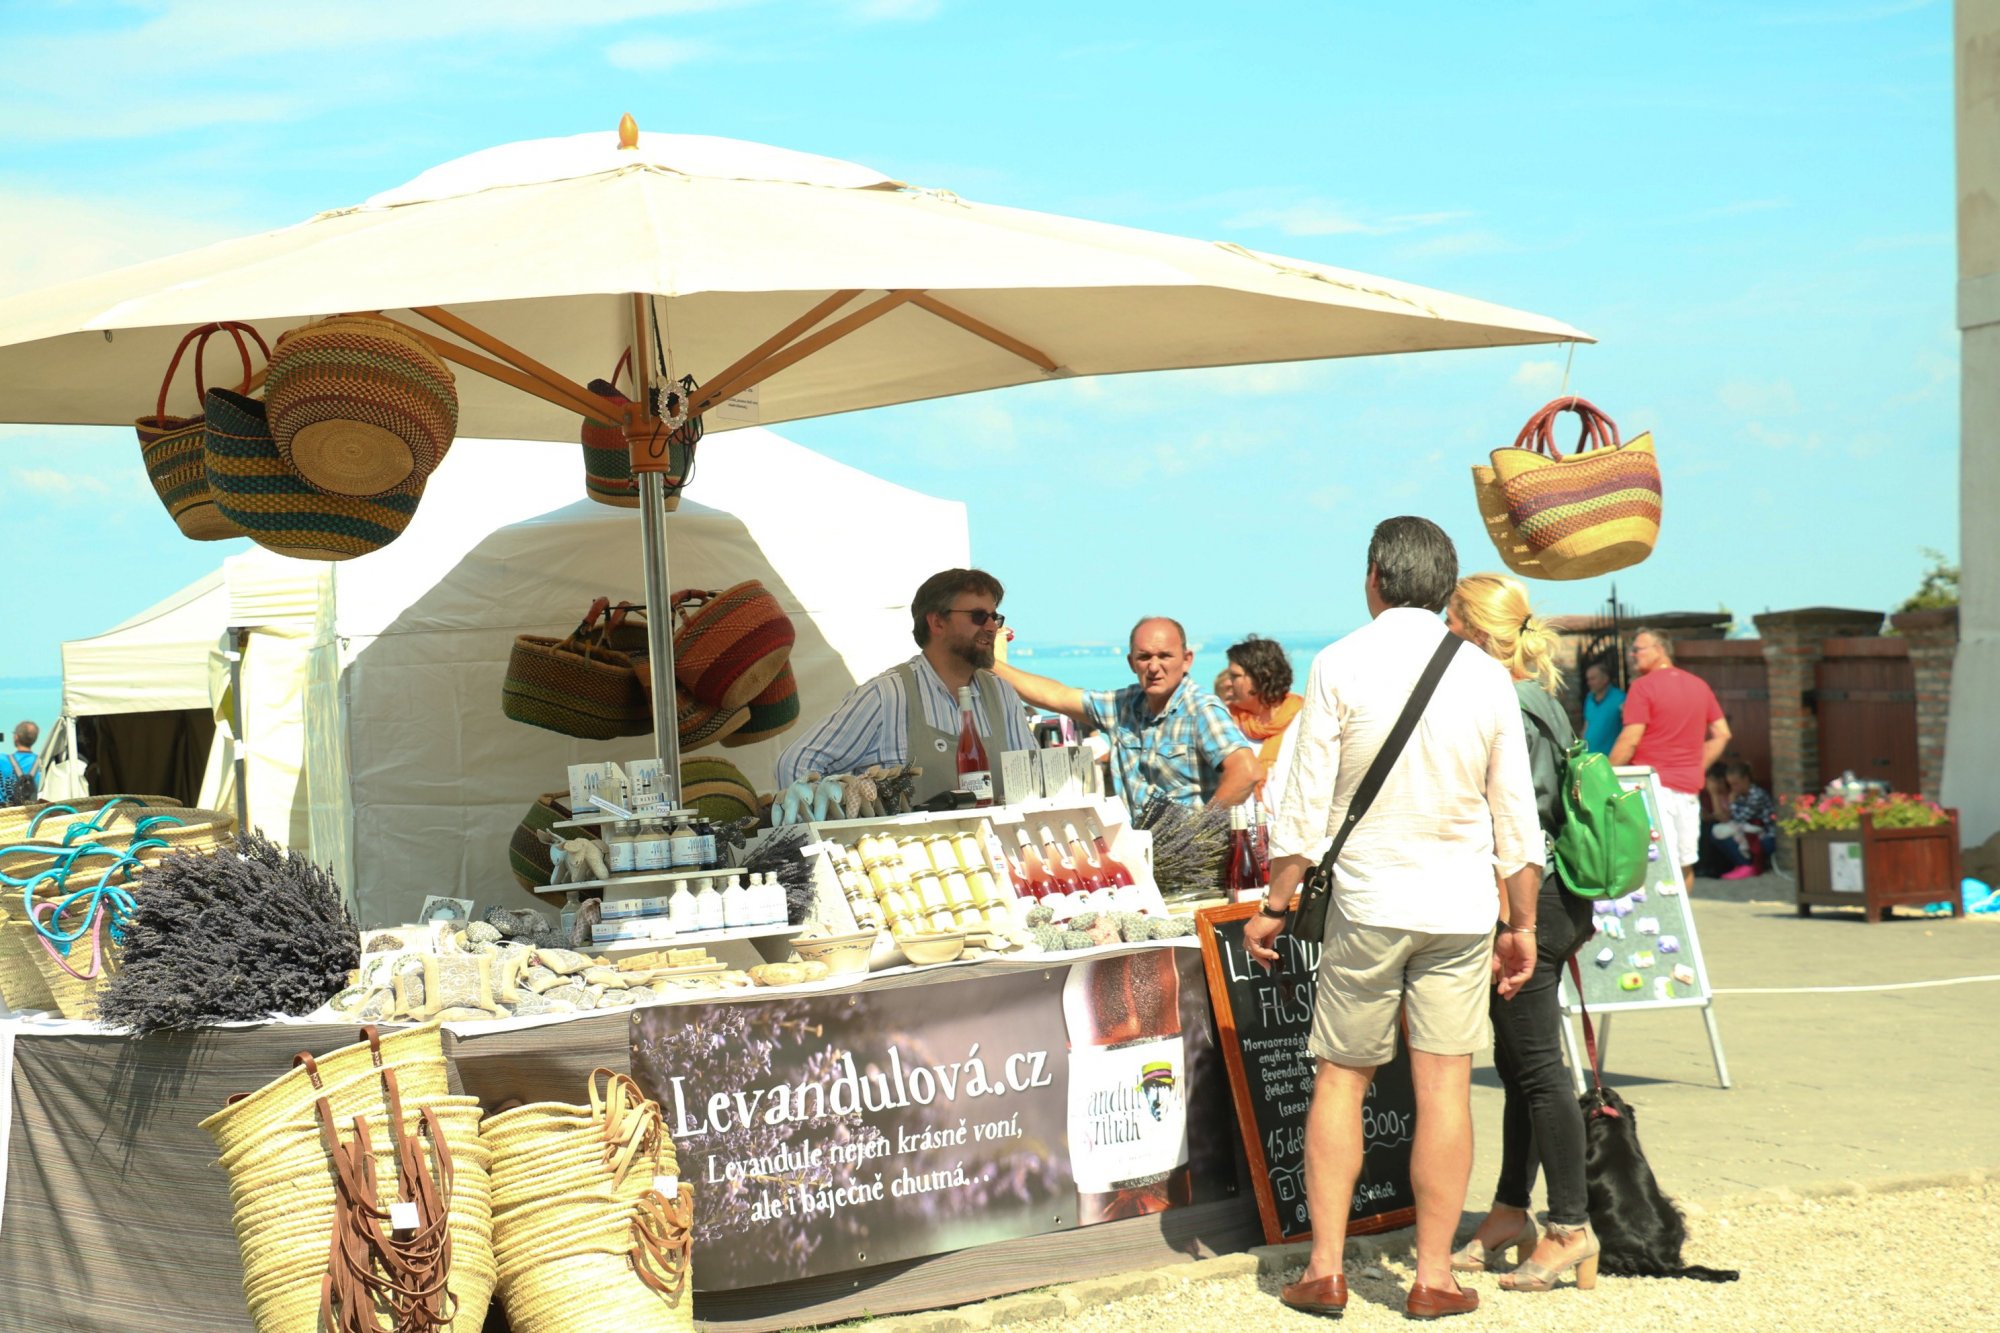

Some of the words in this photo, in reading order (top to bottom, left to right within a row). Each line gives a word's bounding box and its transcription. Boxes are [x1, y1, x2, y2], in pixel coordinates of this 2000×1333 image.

[670, 1042, 1053, 1138] Levandulová.cz
[707, 1138, 823, 1184] Levandule
[830, 1136, 891, 1170] nejen
[897, 1118, 967, 1154] krásně
[973, 1112, 1023, 1142] voní,
[750, 1190, 783, 1222] ale
[787, 1189, 797, 1215] i
[800, 1173, 885, 1219] báječně
